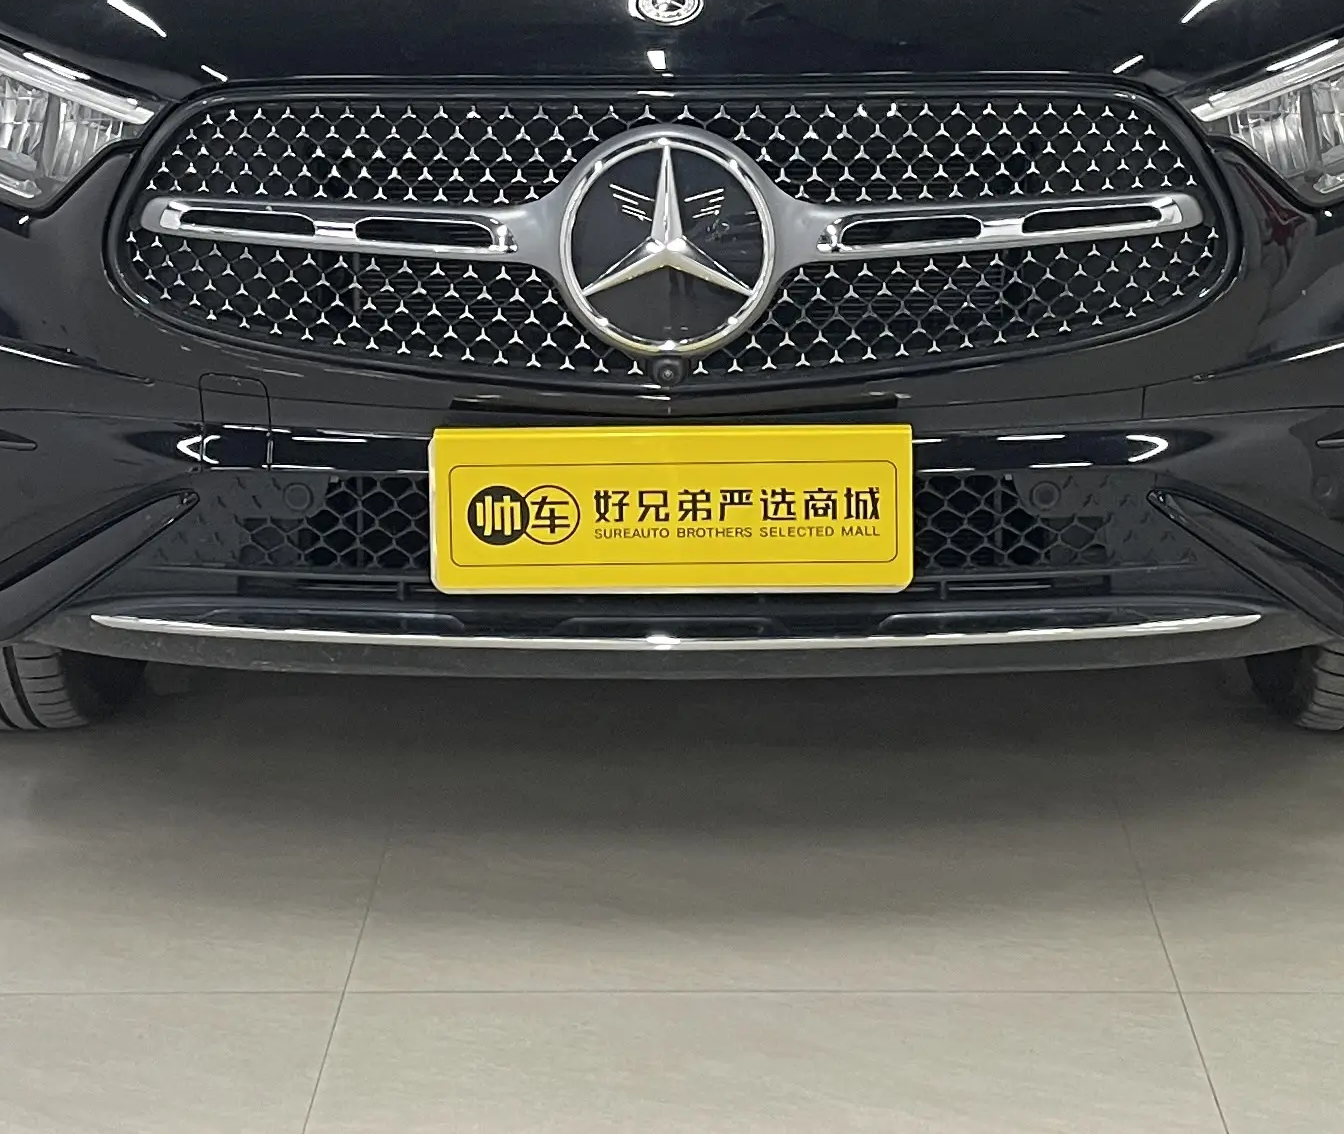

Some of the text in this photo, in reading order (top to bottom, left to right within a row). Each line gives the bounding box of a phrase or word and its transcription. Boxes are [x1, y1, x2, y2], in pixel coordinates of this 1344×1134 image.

[475, 493, 571, 537] 帅车
[593, 486, 880, 523] 好兄弟严选商城
[594, 525, 879, 539] SUREAUTO BROTHERS SELECTED MALL
